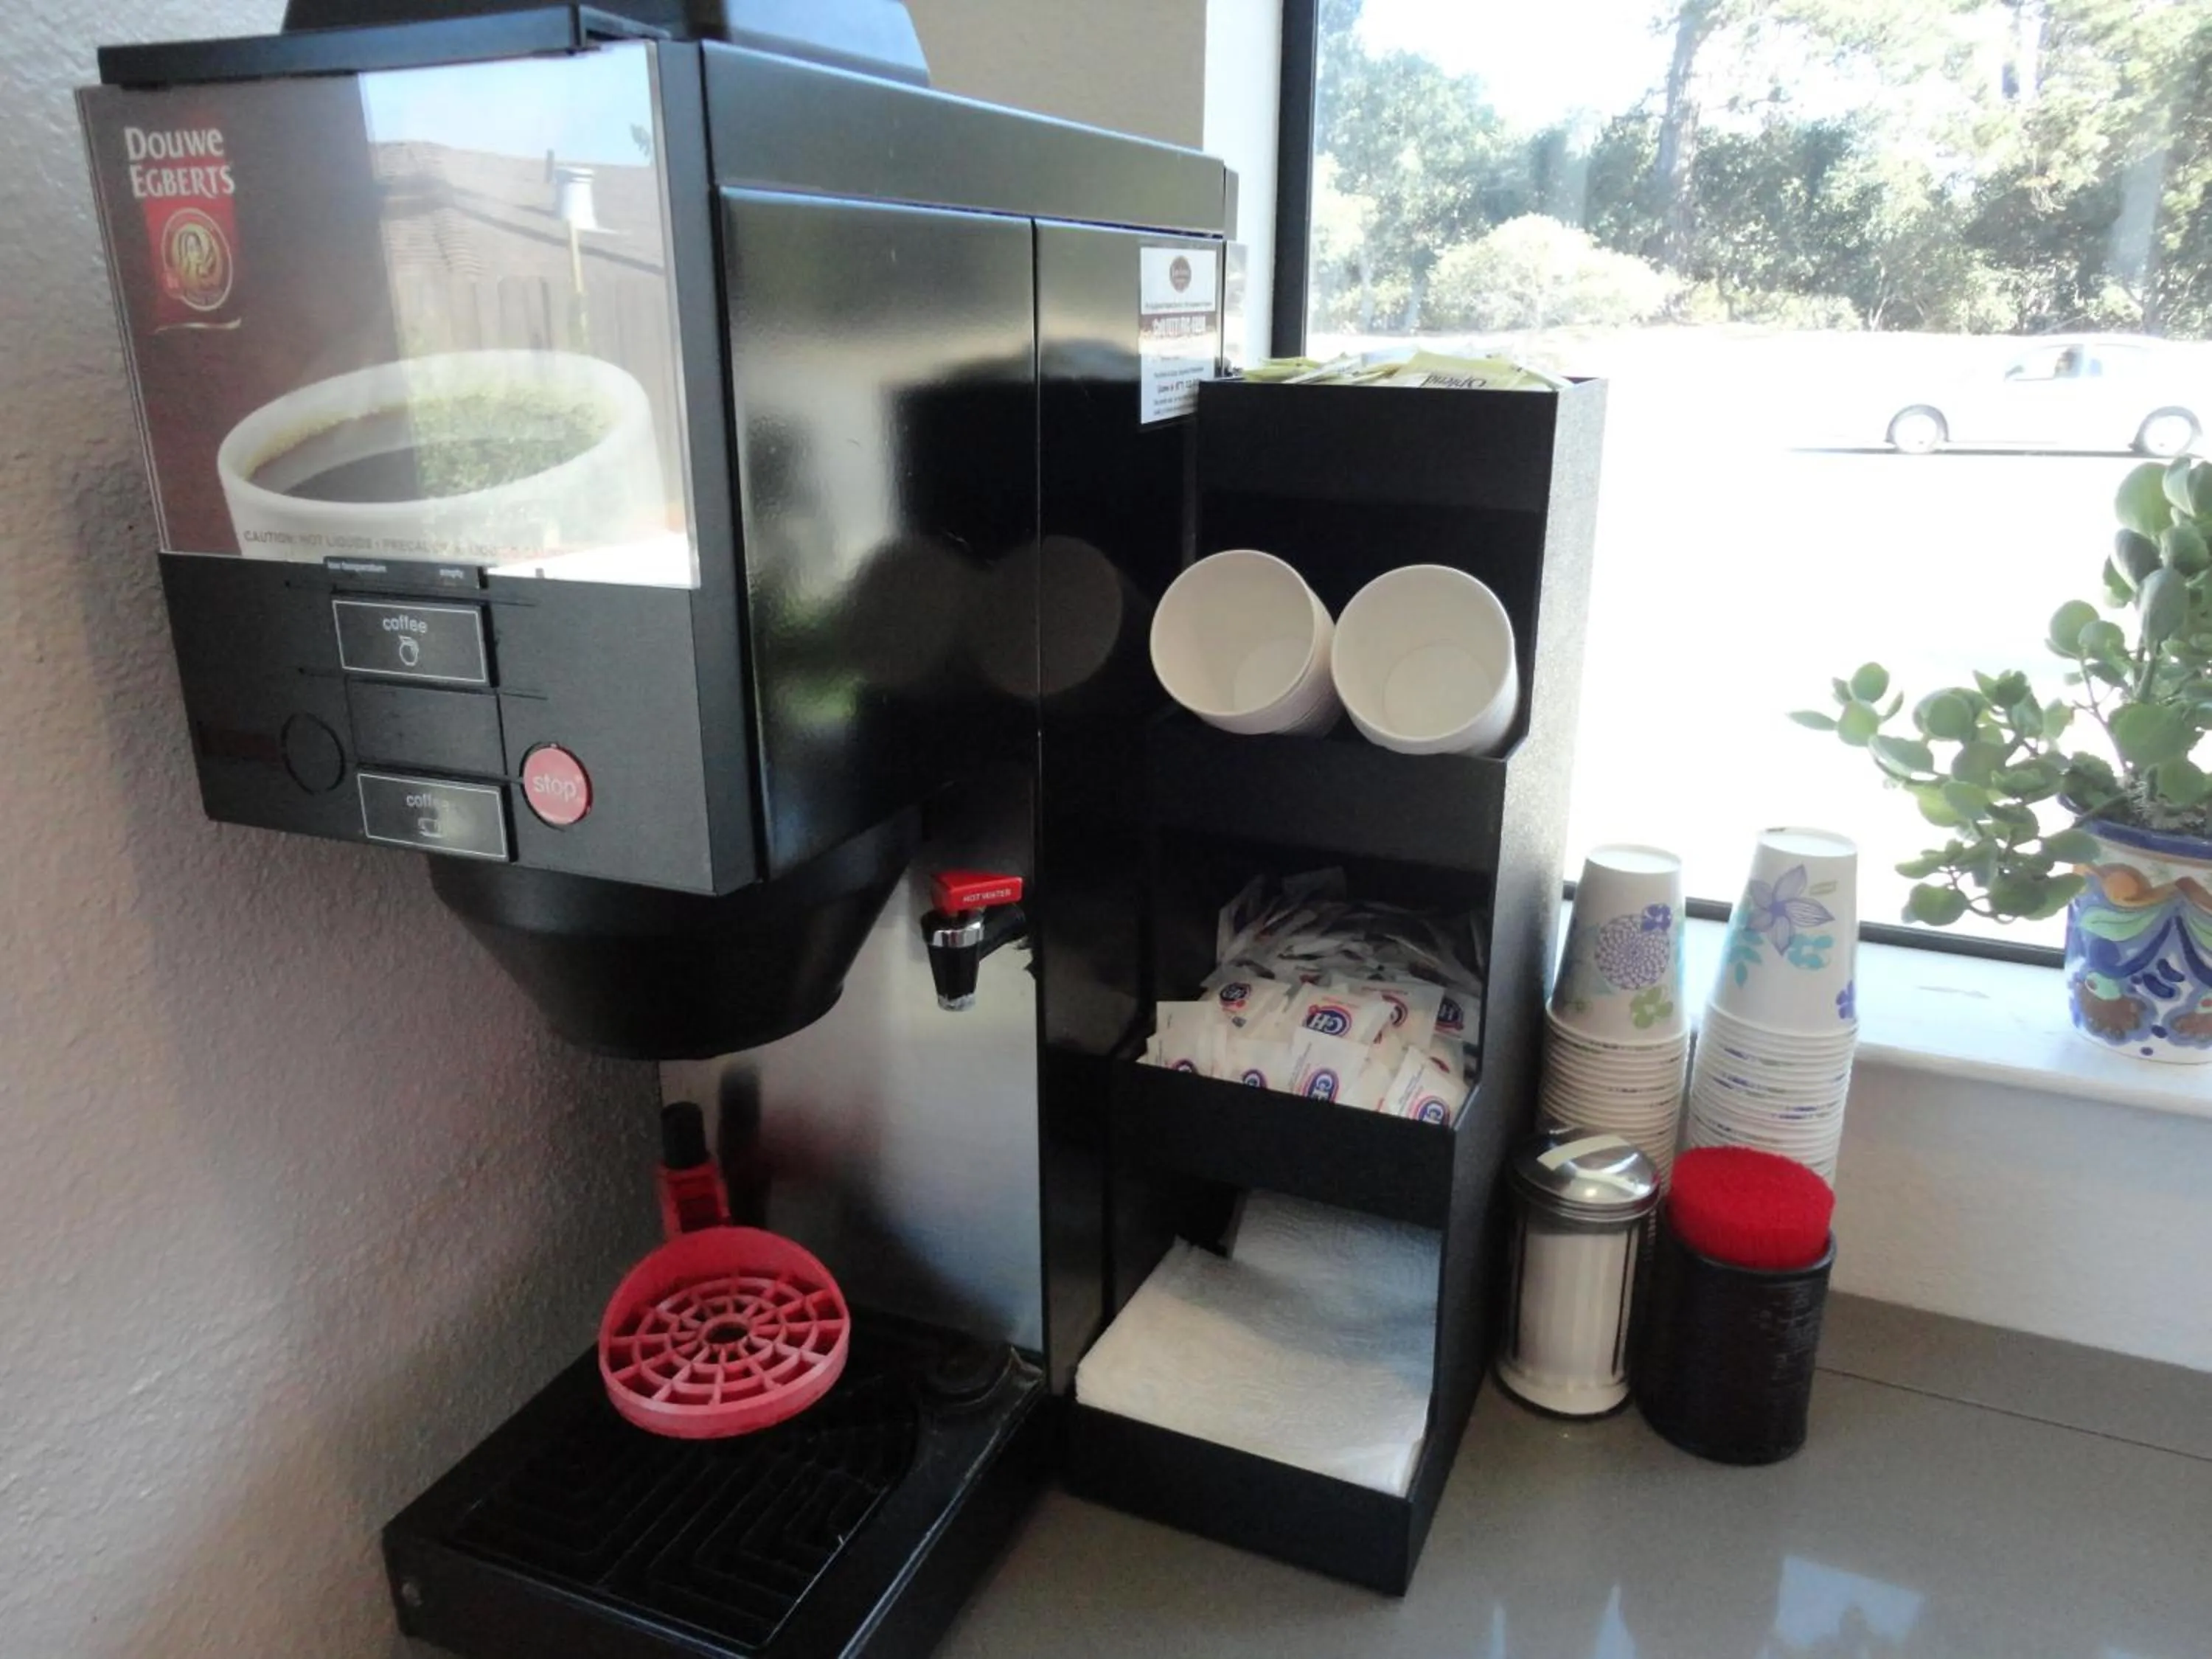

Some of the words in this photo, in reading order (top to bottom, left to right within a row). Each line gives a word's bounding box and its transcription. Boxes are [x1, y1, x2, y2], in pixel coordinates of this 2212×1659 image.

[130, 164, 235, 198] EGBERTS
[383, 614, 428, 633] coffee
[533, 773, 577, 803] stop
